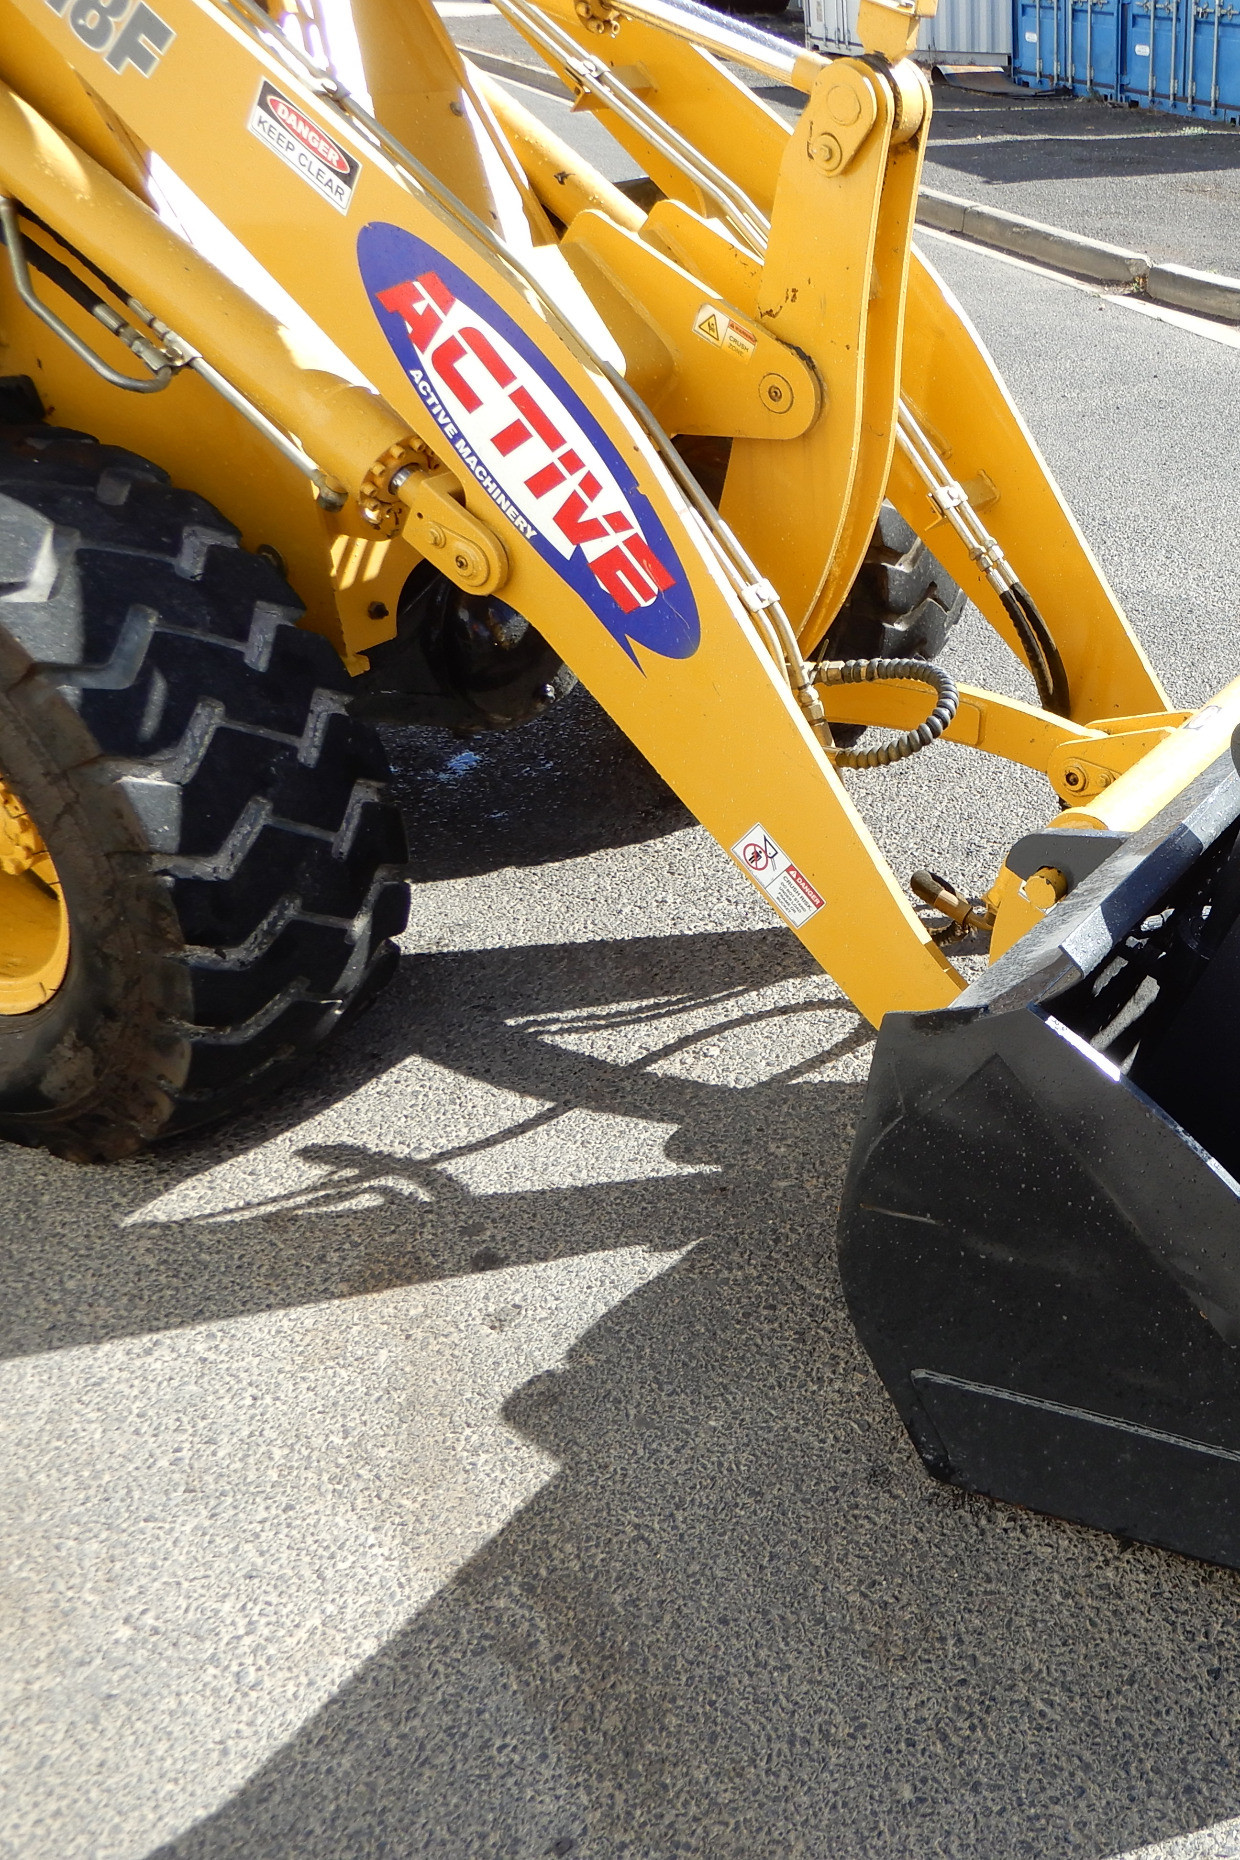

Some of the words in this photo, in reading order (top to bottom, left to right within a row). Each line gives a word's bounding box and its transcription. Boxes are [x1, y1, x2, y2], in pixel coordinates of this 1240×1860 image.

[258, 115, 295, 152] KEEP
[298, 153, 345, 202] CLEAR
[276, 103, 340, 168] DANGER
[729, 335, 750, 352] CRUSH
[409, 369, 458, 439] ACTIVE
[455, 438, 538, 540] MACHINERY
[783, 876, 801, 896] CRUSH
[796, 877, 820, 905] DANGER
